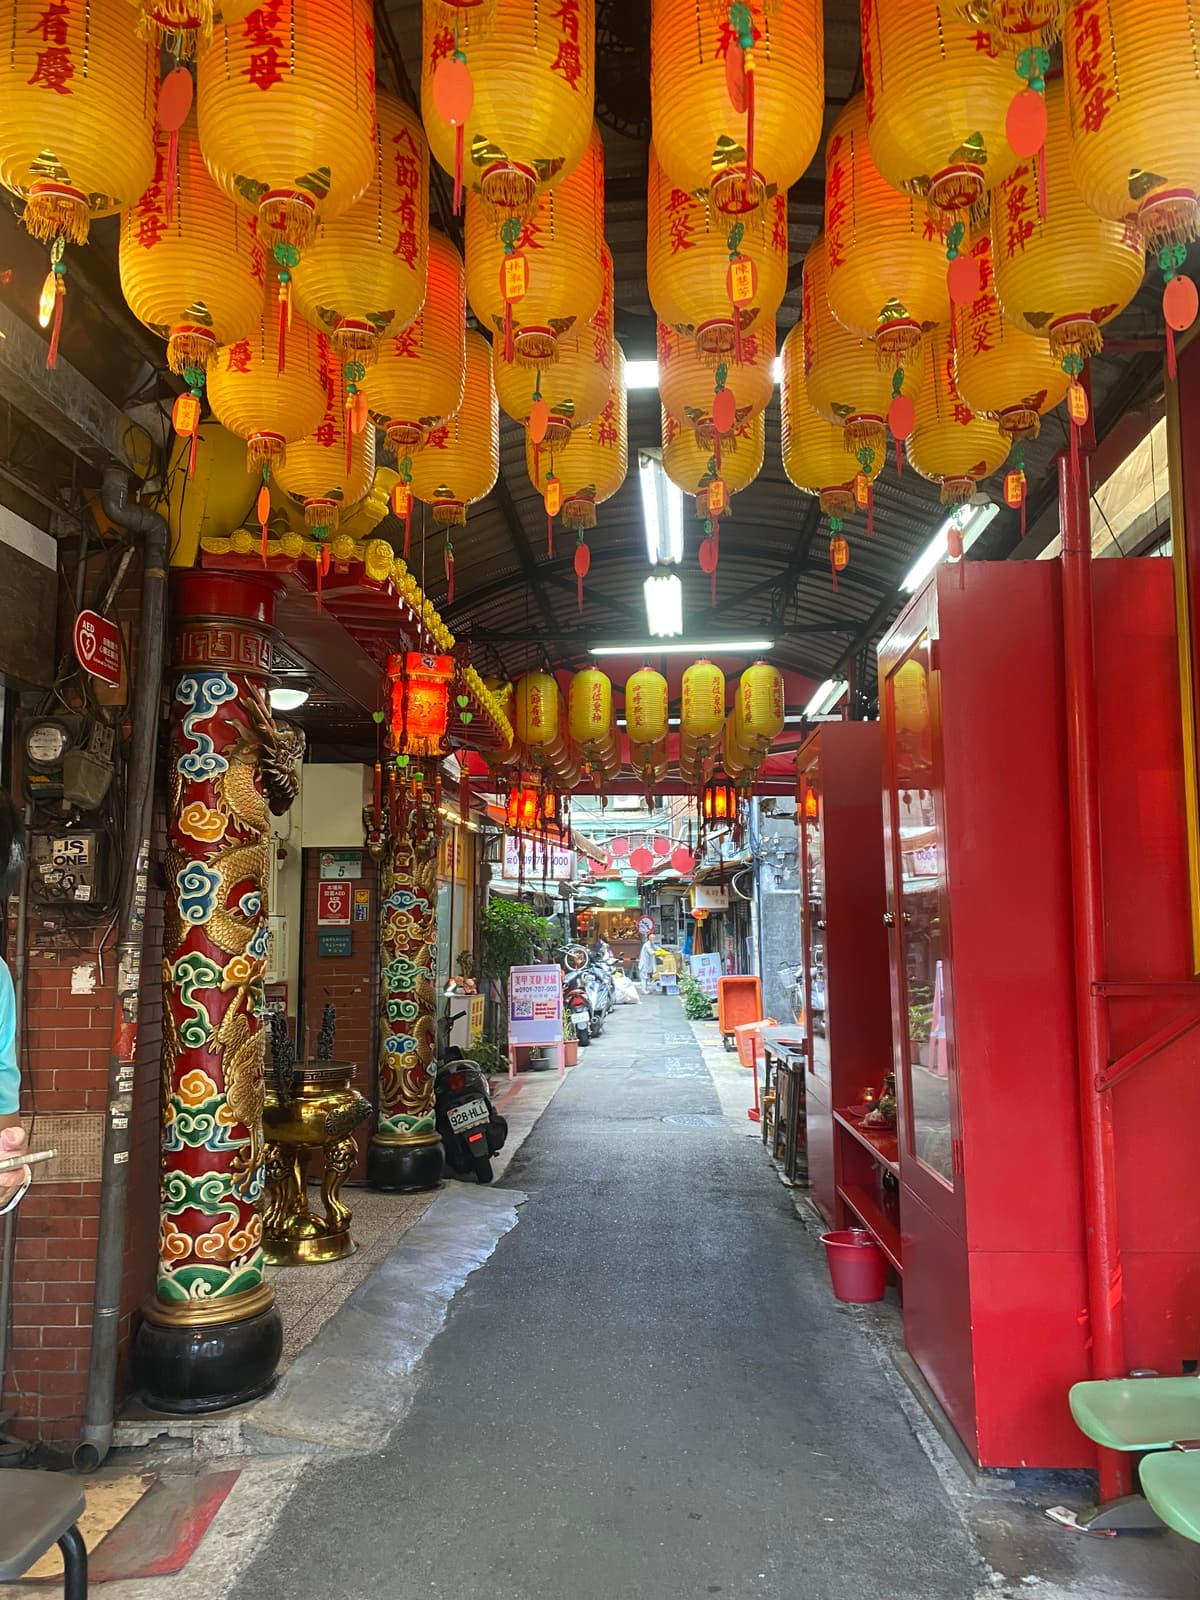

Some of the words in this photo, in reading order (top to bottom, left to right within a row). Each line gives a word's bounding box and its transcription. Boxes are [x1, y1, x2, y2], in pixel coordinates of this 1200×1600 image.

[393, 127, 424, 271] 八節有慶
[81, 619, 95, 633] AED
[53, 854, 88, 865] ONE
[337, 865, 345, 877] 5
[451, 1106, 487, 1127] 928-HLL
